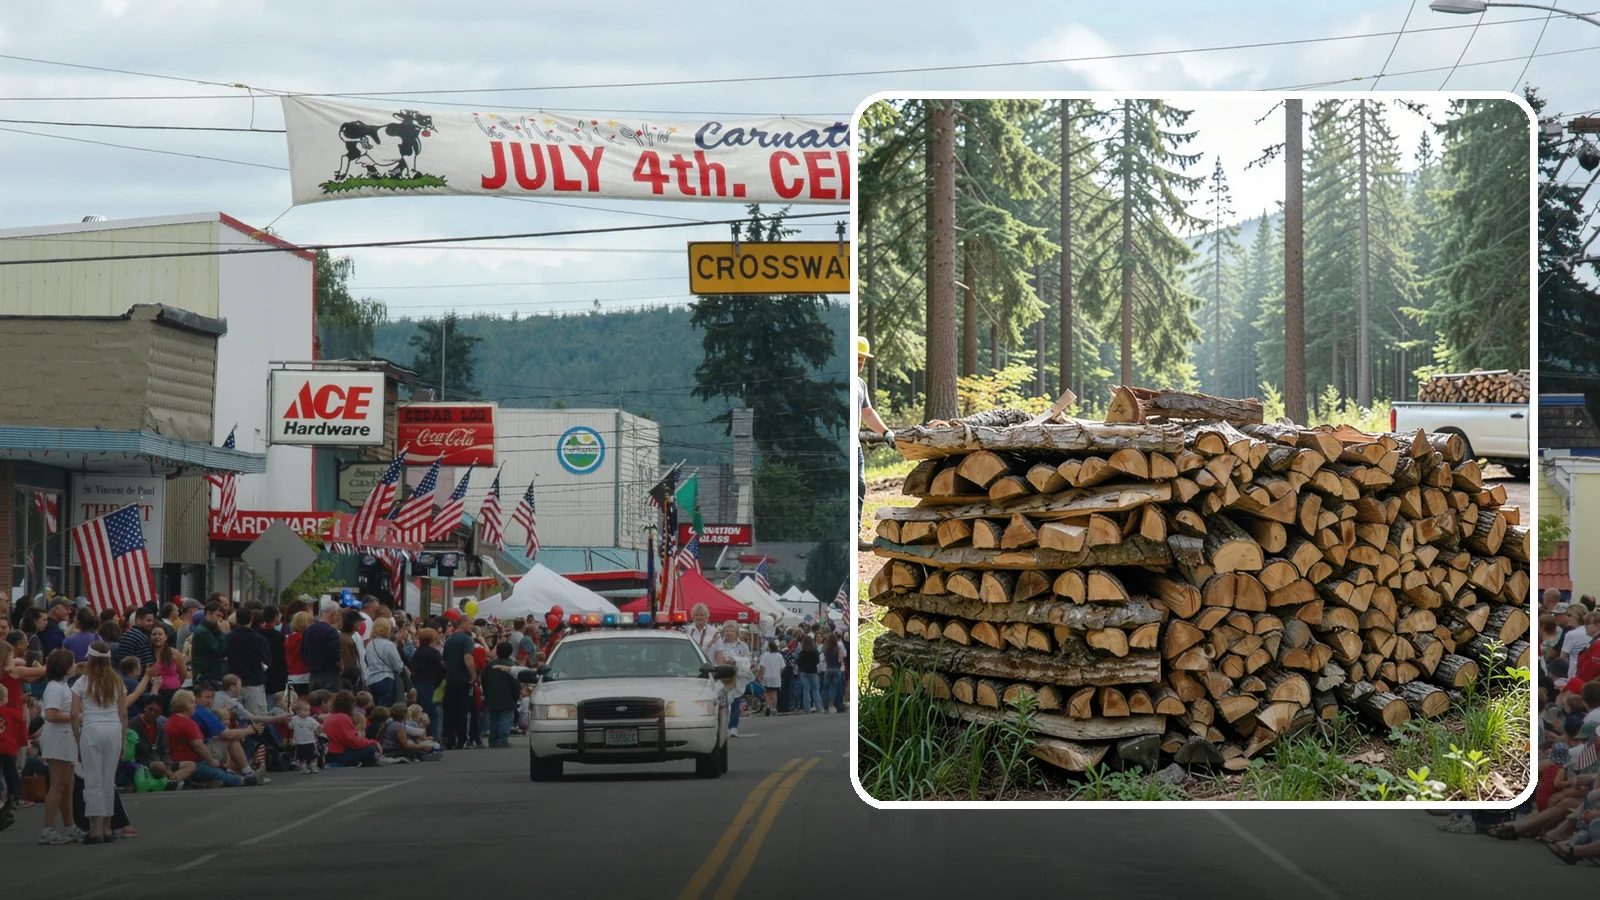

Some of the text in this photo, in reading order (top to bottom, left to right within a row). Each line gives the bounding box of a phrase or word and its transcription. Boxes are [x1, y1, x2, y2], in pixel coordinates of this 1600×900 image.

[481, 141, 605, 192] JULY
[632, 150, 746, 197] 4th.
[697, 254, 850, 280] CROSSWA
[283, 380, 373, 420] ACE
[405, 409, 485, 422] CEDAR LOG
[283, 421, 370, 436] Hardware
[416, 428, 477, 447] Coca-Cola
[96, 485, 124, 495] Vincent
[126, 485, 136, 495] de
[137, 486, 155, 495] Paul
[688, 526, 741, 535] CRNATION
[699, 535, 730, 543] GLASS
